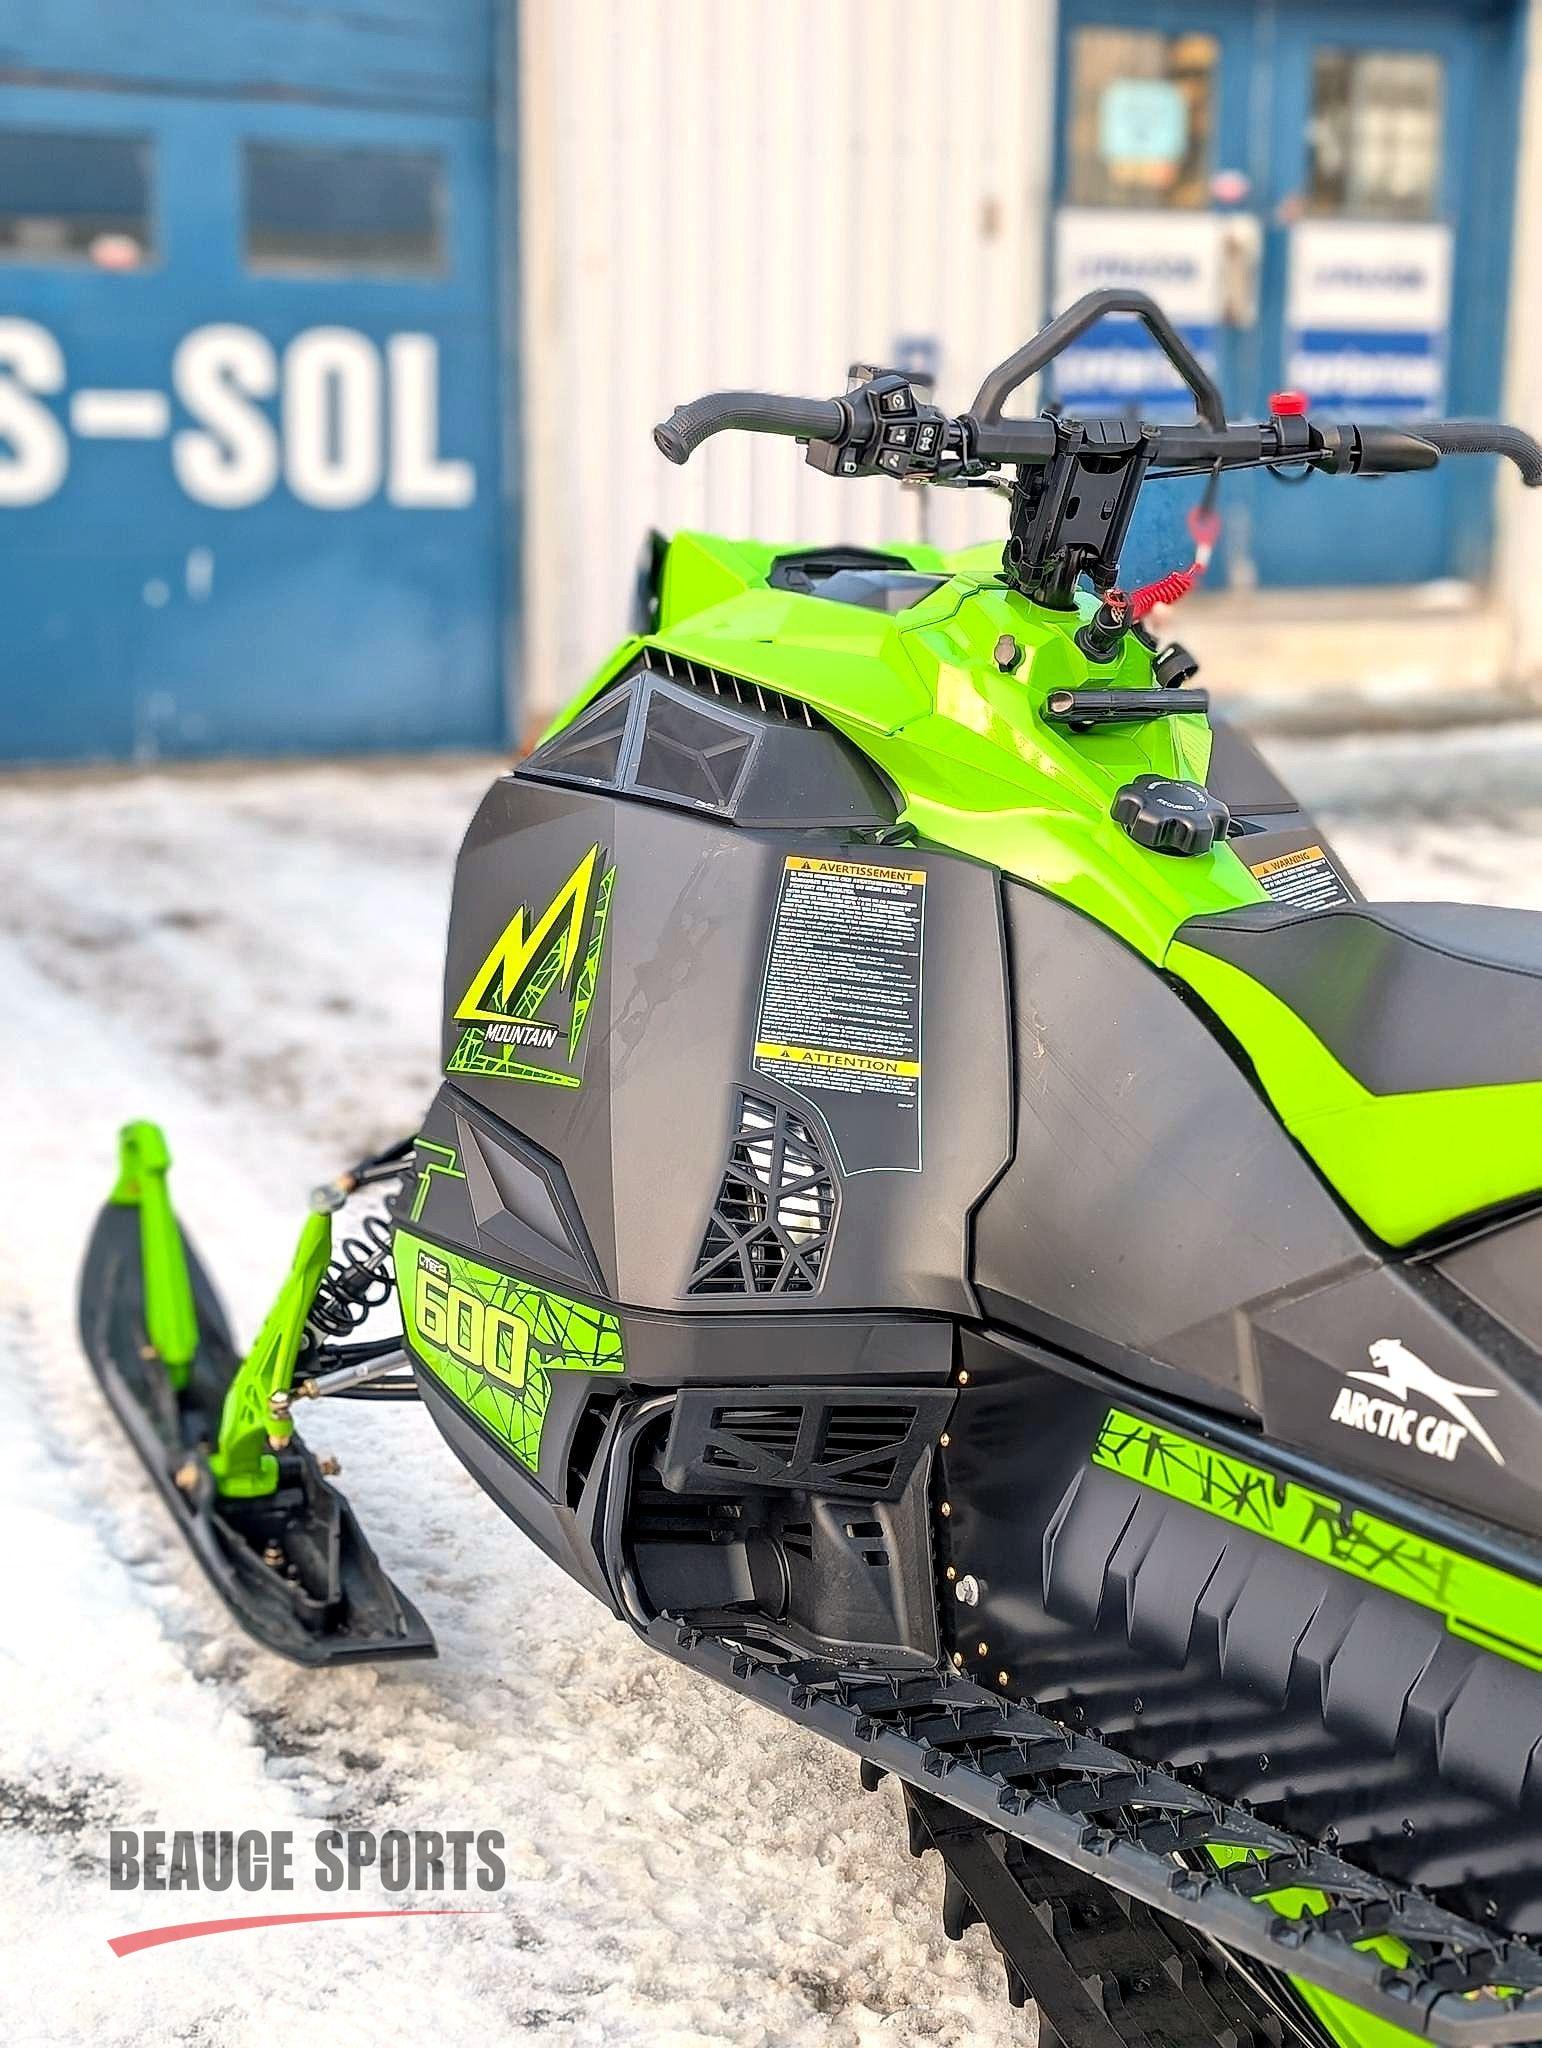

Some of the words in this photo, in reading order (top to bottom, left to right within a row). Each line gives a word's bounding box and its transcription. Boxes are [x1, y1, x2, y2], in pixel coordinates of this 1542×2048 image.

[0, 314, 476, 511] S-SOL
[819, 862, 913, 881] AVERTISSEMENT
[1270, 852, 1310, 870] WARNING
[484, 1024, 558, 1048] MOUNTAIN
[802, 1052, 898, 1073] ATTENTION
[415, 1268, 530, 1390] 600
[1330, 1387, 1418, 1446] ARCTIC
[1416, 1416, 1467, 1462] CAT
